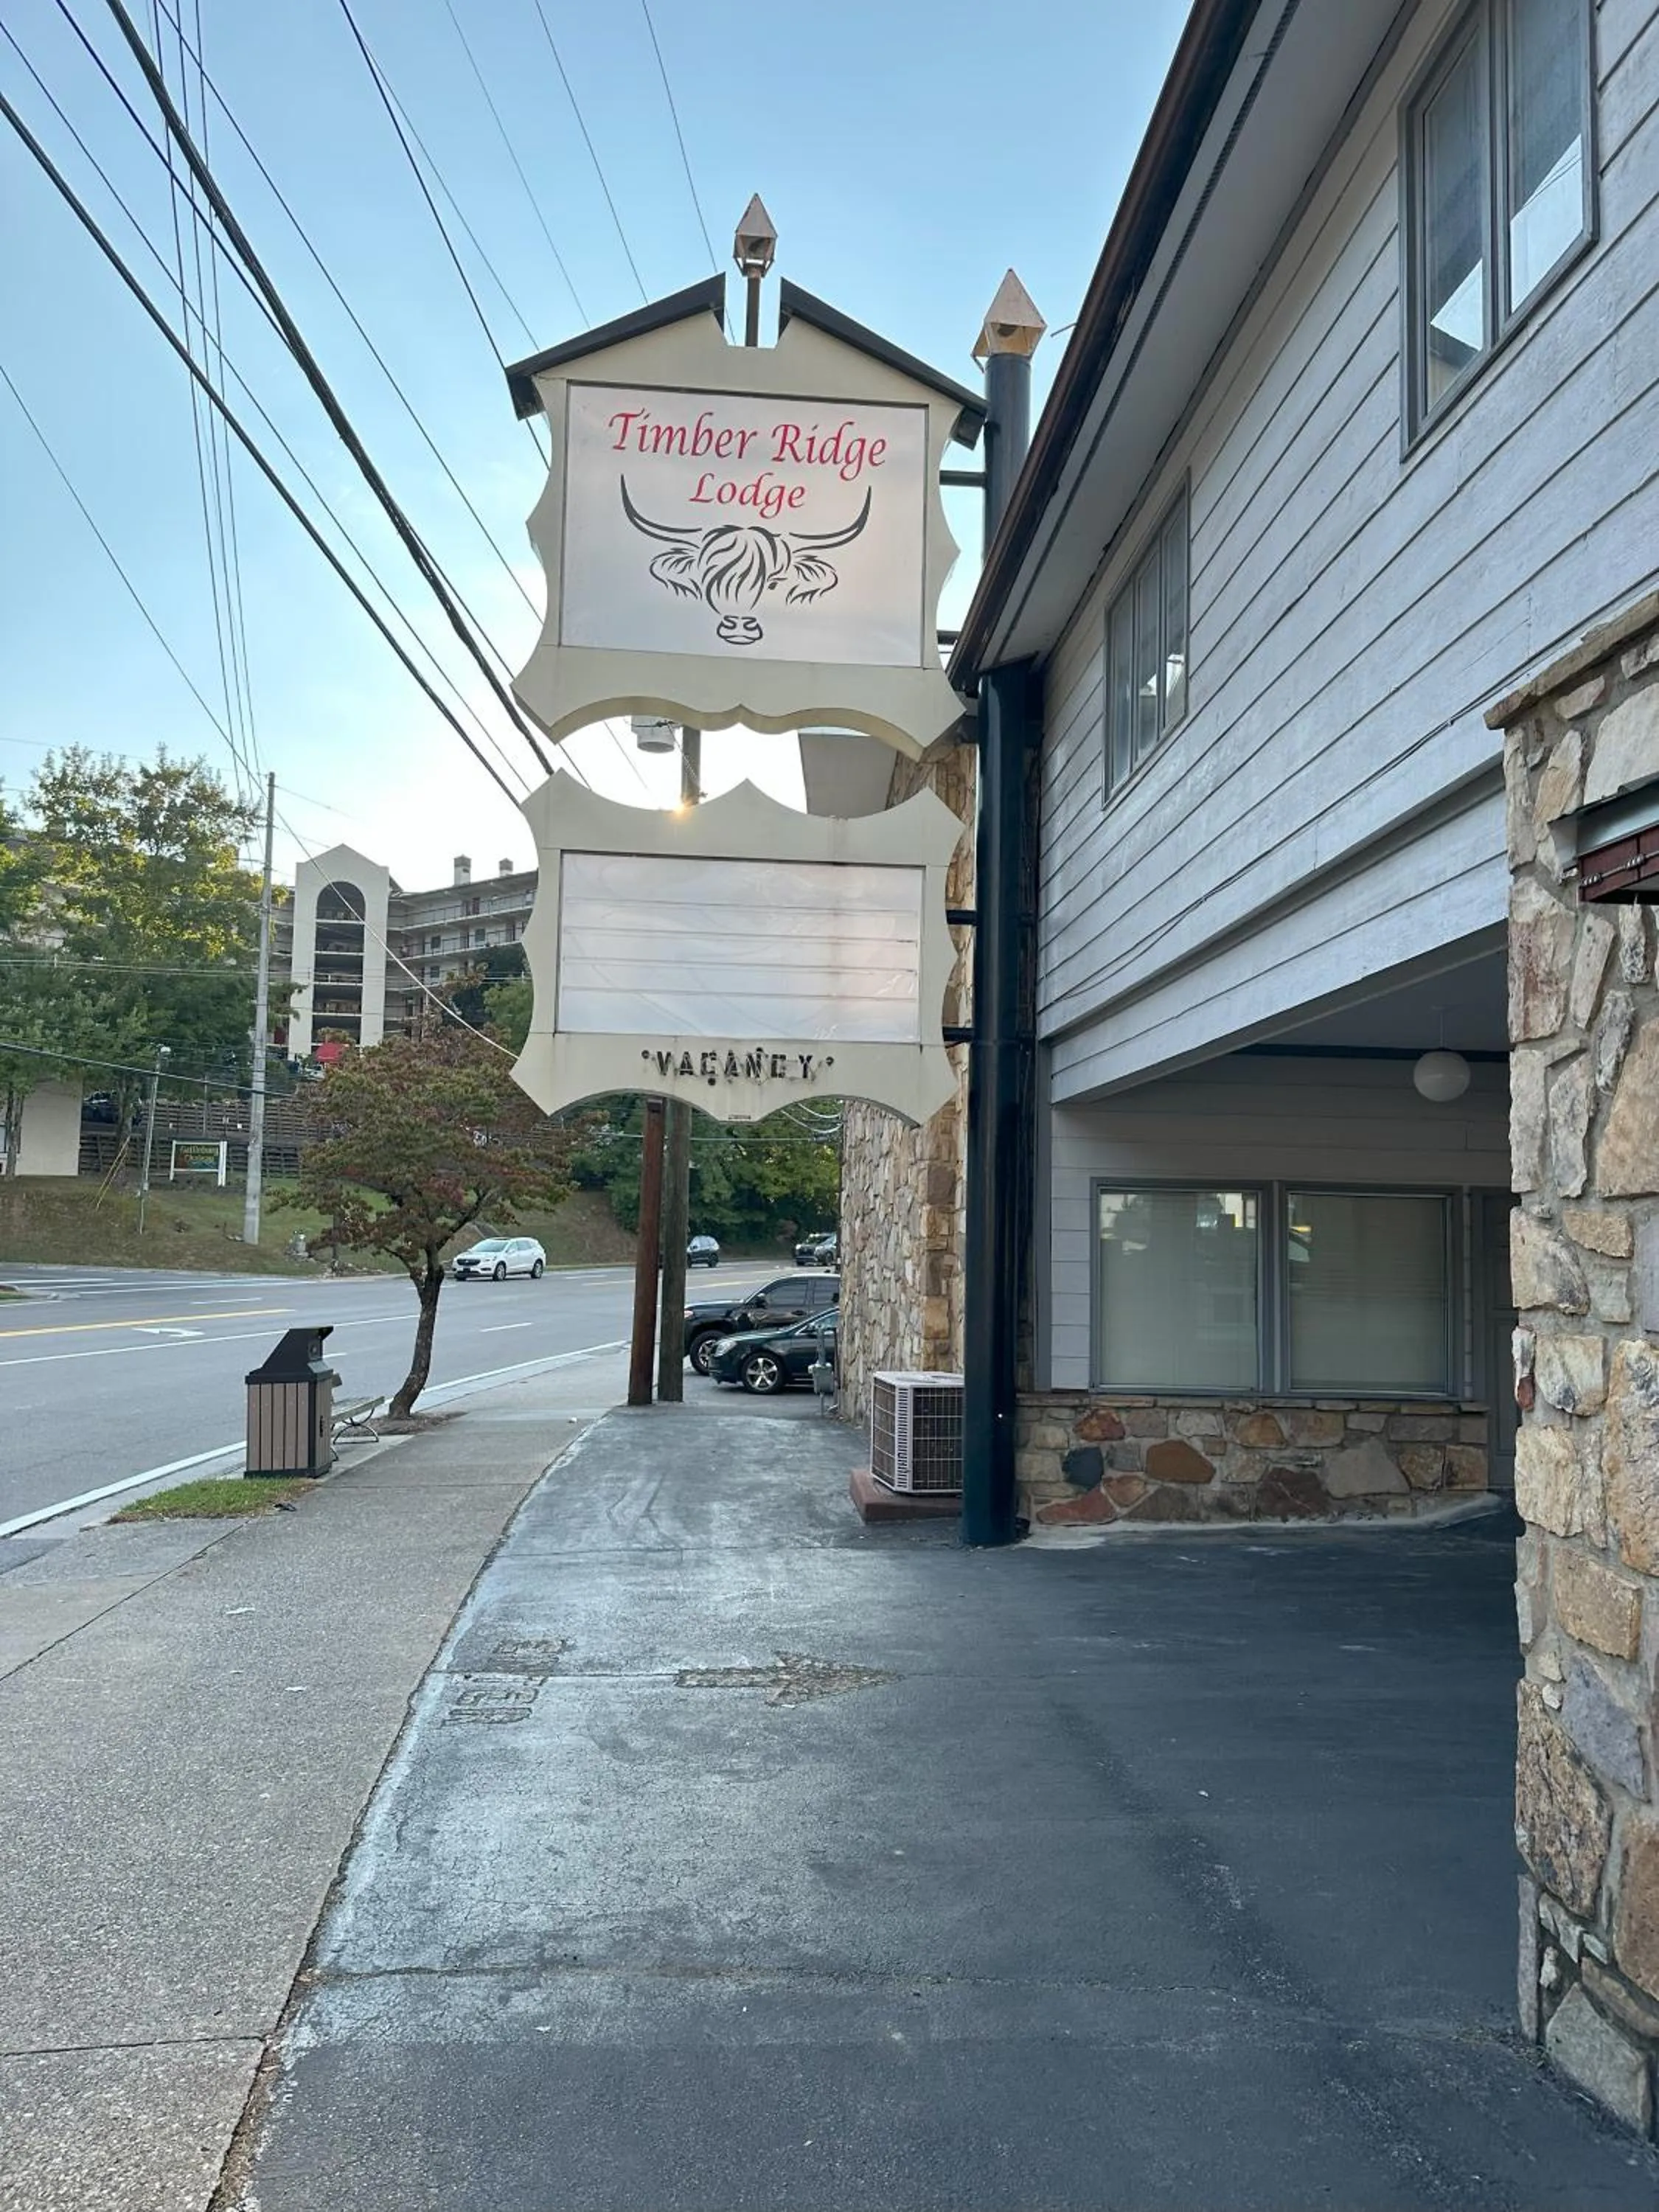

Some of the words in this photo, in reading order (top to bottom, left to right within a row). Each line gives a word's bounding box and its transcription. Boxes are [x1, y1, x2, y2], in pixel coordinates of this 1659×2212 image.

[608, 408, 758, 459] Timber
[771, 421, 887, 481] Ridge
[689, 473, 806, 519] Lodge
[656, 1051, 813, 1079] VACANCY
